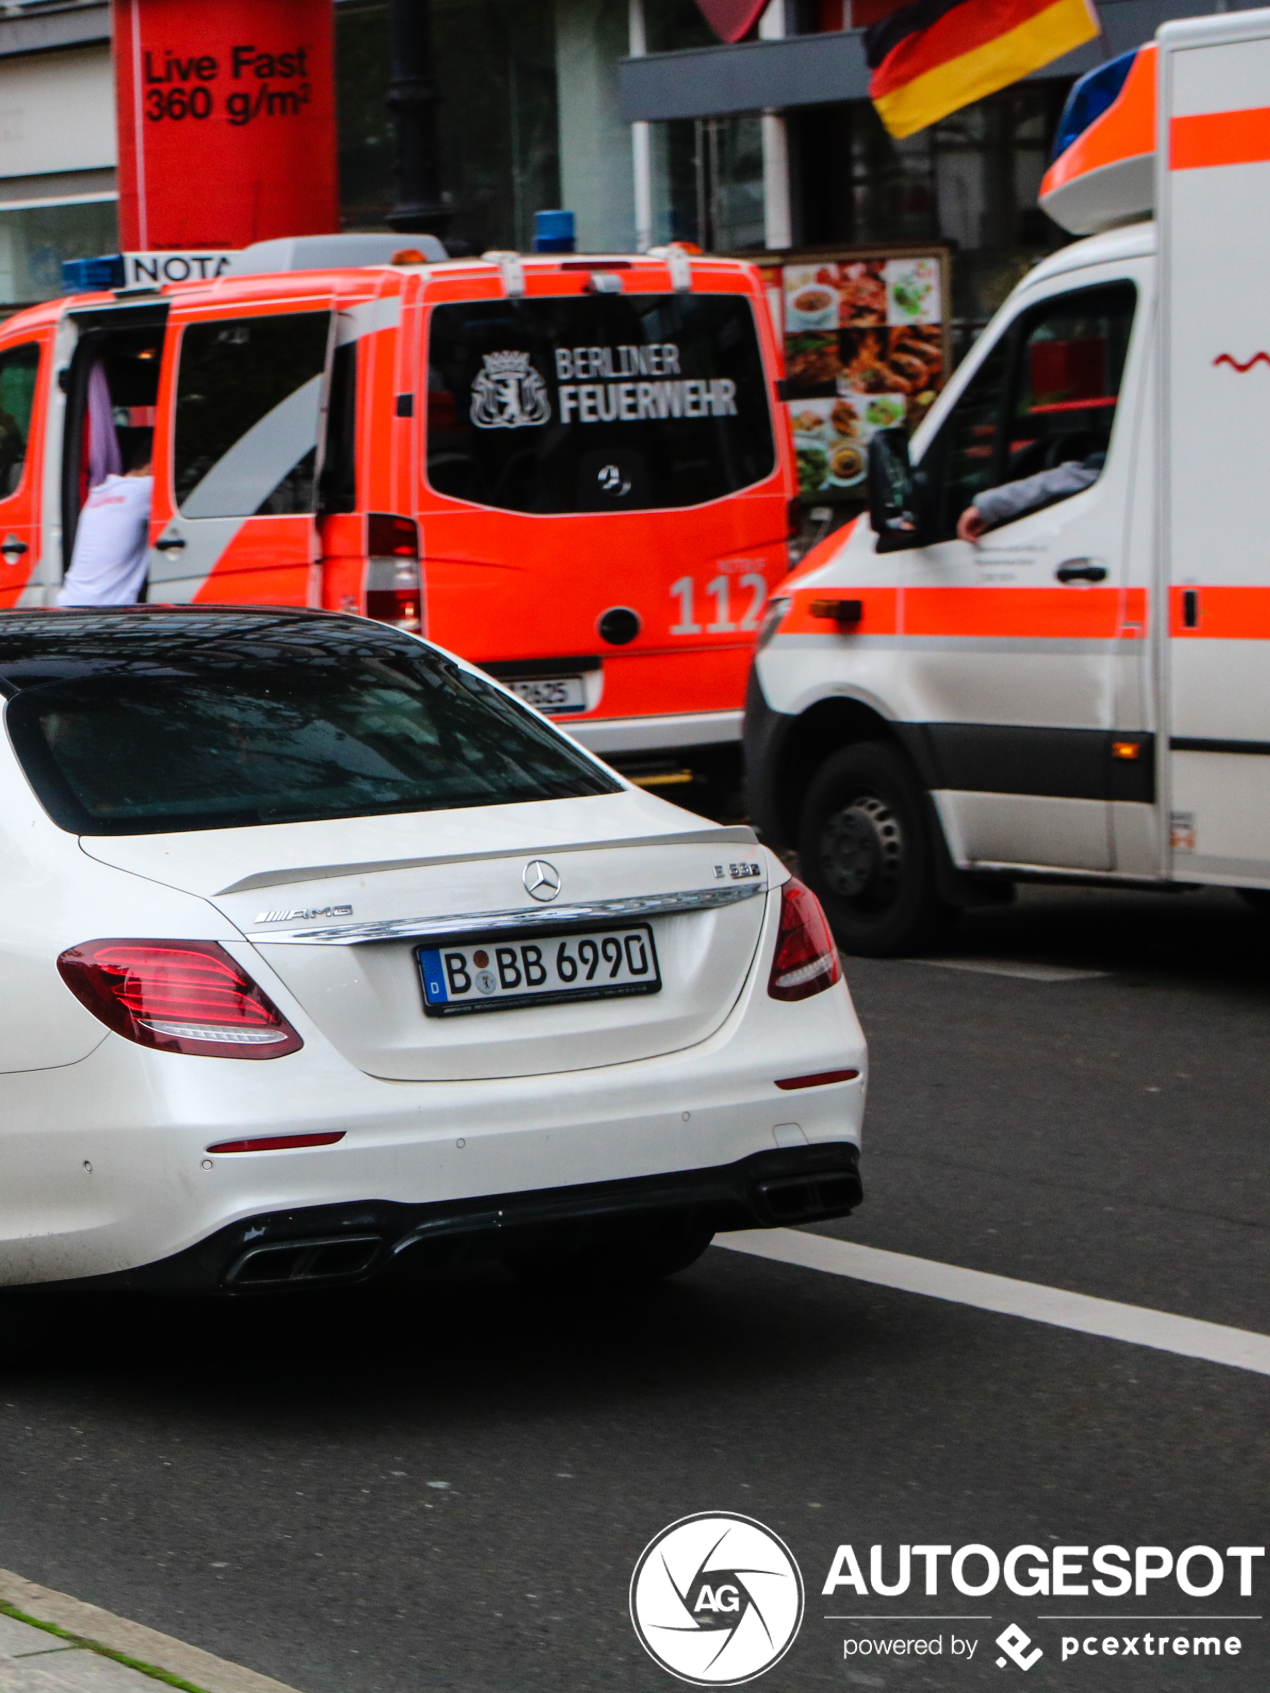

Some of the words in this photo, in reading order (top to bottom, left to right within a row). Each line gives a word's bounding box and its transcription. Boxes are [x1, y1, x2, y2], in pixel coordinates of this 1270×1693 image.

[145, 50, 217, 83] Live
[232, 46, 307, 79] Fast
[146, 86, 212, 121] 360
[555, 343, 680, 380] BERLINER
[558, 378, 738, 424] FEUERWEHR
[670, 573, 768, 635] 112
[444, 953, 472, 995] B
[495, 945, 547, 990] BB
[556, 934, 649, 983] 6990
[430, 982, 440, 994] D
